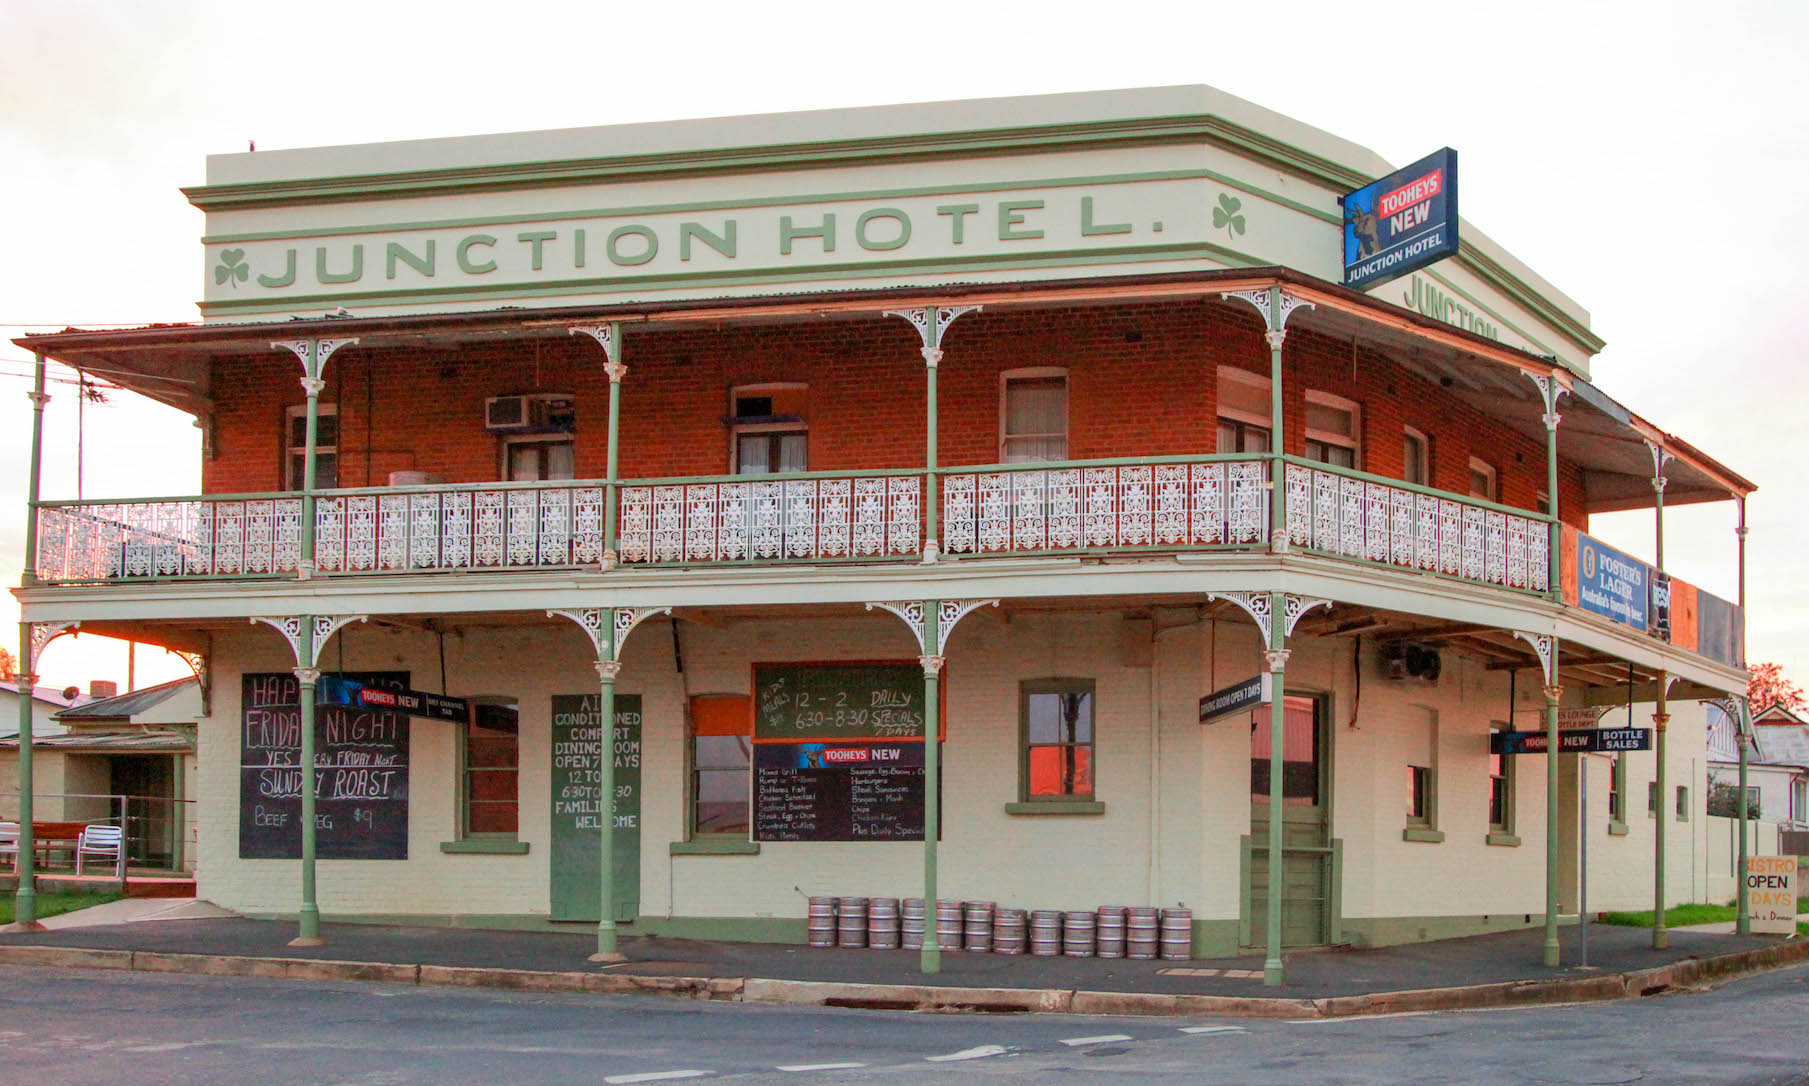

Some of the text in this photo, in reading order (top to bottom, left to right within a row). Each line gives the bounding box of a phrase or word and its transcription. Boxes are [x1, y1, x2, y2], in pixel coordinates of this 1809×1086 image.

[1382, 174, 1438, 214] TOOHEYS
[1391, 199, 1431, 237] NEW
[257, 219, 737, 288] JUNCTION
[1348, 232, 1442, 283] JUNCTION HOTEL
[1600, 553, 1641, 586] FOSTER'S
[1600, 573, 1632, 601] LAGER
[362, 689, 420, 709] TOOHEYS NEW
[580, 694, 601, 711] AI
[795, 692, 810, 710] 12
[835, 691, 847, 707] 2
[870, 689, 911, 706] DAILY
[555, 712, 641, 725] CONDITONED
[1568, 710, 1597, 719] LOUNGE
[246, 709, 397, 747] FRIDA NIGHT
[886, 727, 917, 736] DAYS
[1557, 721, 1577, 729] OTTLE
[570, 727, 630, 741] COMFRT
[1603, 730, 1643, 740] BOTTLE
[555, 741, 640, 756] DINING OOM
[1564, 736, 1589, 747] NEW
[1606, 739, 1640, 749] SALES
[266, 751, 292, 766] YES
[337, 751, 371, 766] FRIDAY
[825, 749, 901, 760] TOOHEYS NEW
[555, 755, 640, 769] OPEN 7 AYS
[260, 768, 396, 796] SUNDY ROAST
[568, 770, 601, 784] 12 TO
[555, 800, 617, 814] FAMILIS
[354, 807, 373, 829] $9
[575, 815, 637, 829] WELOME
[1748, 875, 1787, 889] OPEN
[1751, 891, 1792, 905] DAYS
